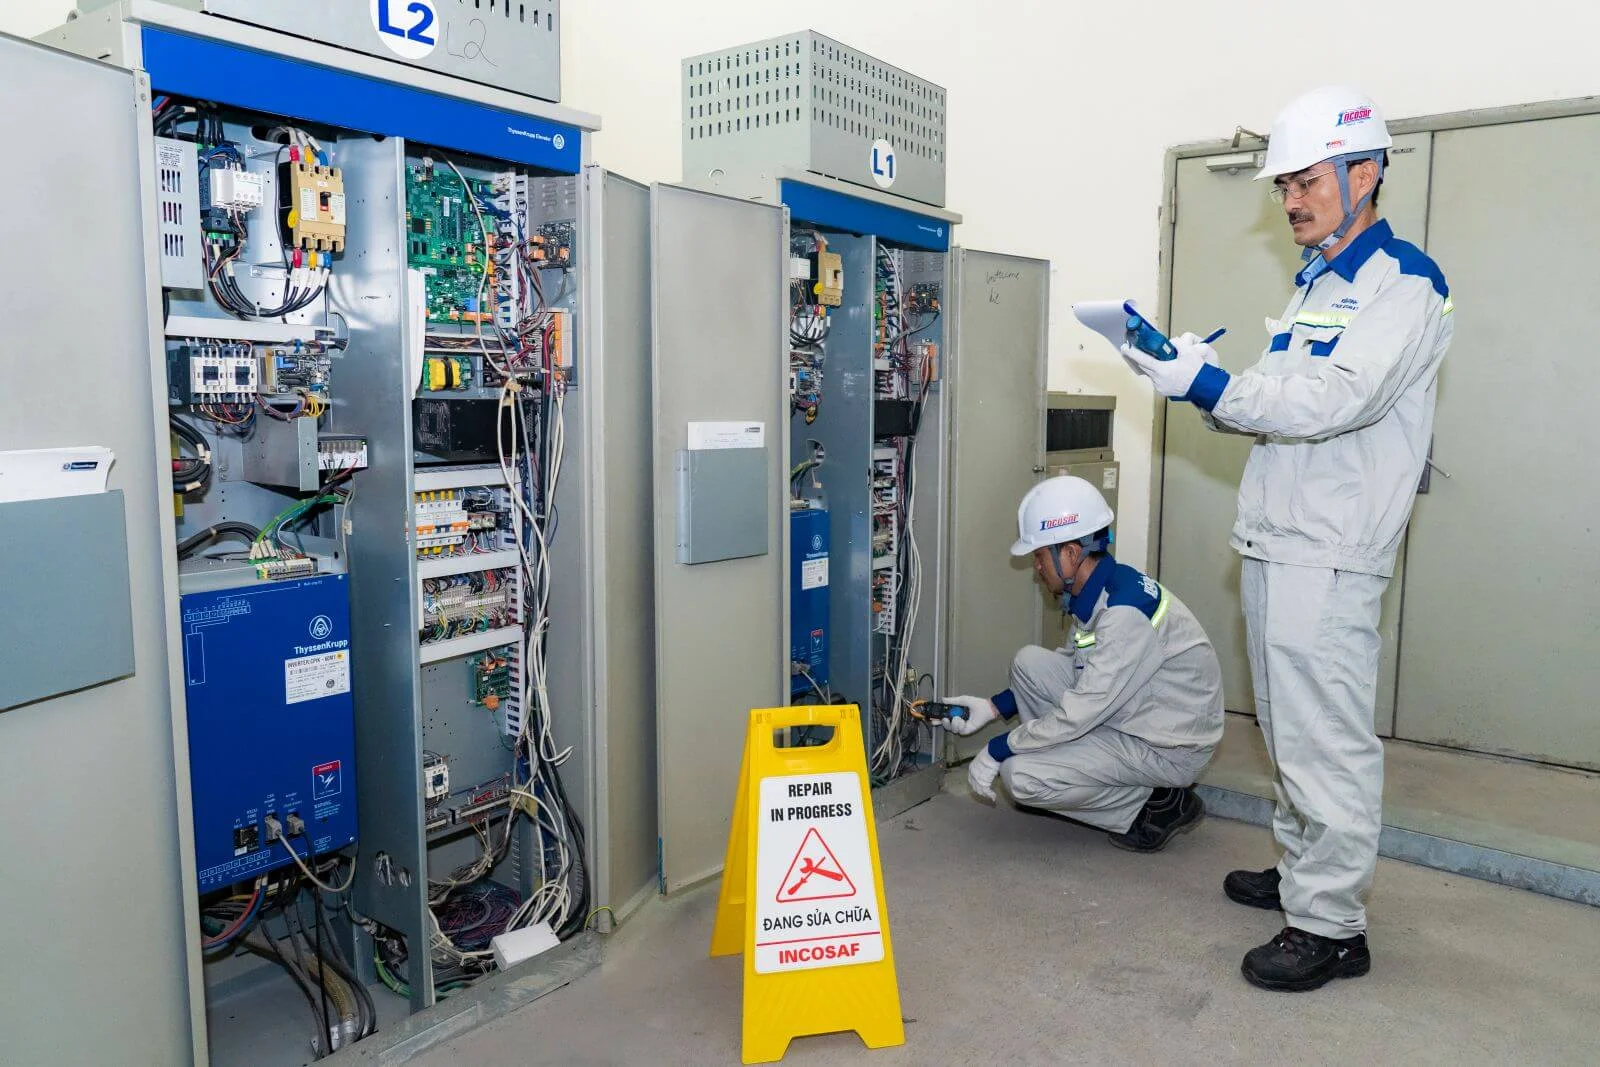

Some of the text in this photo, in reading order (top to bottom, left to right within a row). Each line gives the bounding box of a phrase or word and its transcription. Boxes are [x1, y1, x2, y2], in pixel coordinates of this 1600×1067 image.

[378, 0, 435, 46] L2
[446, 18, 499, 68] L2
[873, 148, 893, 179] L1
[294, 639, 348, 655] ThyssenKrupp
[788, 781, 833, 798] REPAIR
[770, 802, 853, 822] IN PROGRESS
[763, 905, 872, 931] ĐANG SỬA CHỮA
[778, 942, 860, 964] INCOSAF
